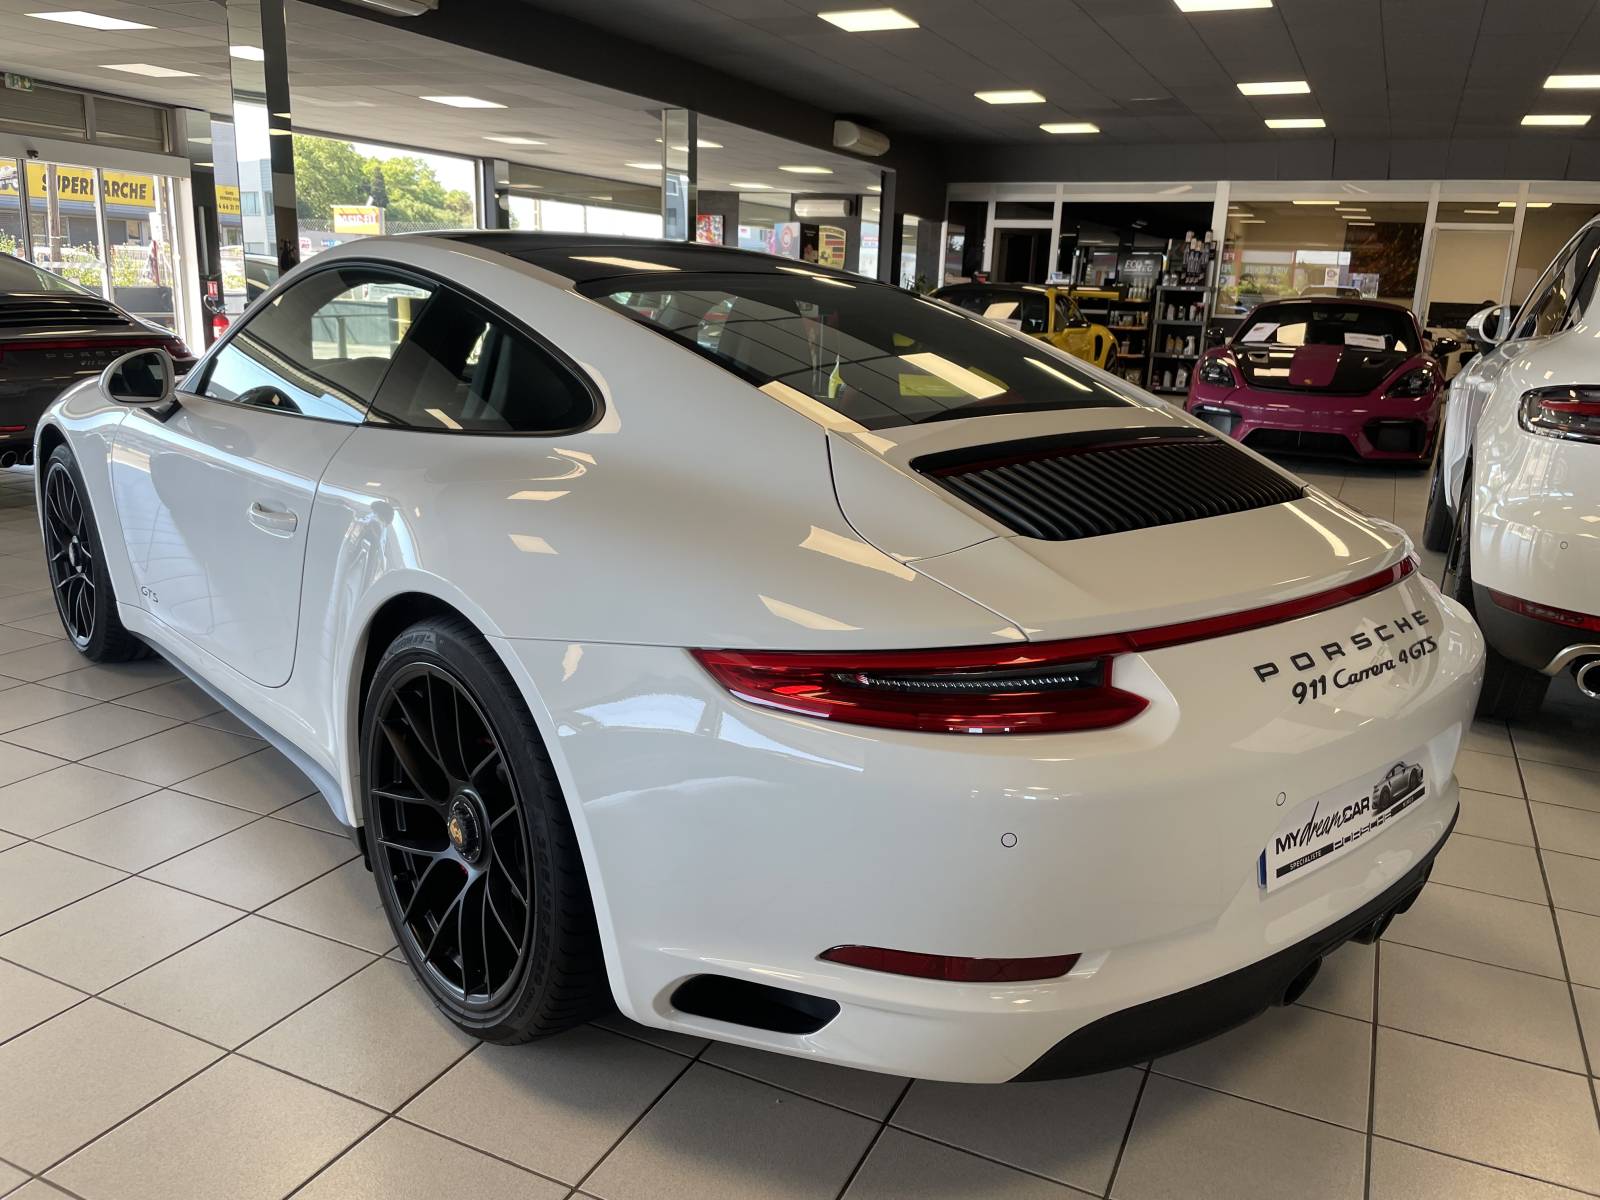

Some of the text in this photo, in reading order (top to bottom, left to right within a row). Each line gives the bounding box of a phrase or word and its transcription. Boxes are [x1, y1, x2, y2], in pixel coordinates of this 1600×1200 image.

[42, 173, 147, 200] SPERARCHE
[141, 586, 159, 603] GTS
[1253, 610, 1430, 683] PORSCHE
[1292, 674, 1327, 705] 911
[1333, 659, 1396, 689] Carrera
[1289, 850, 1322, 870] SPECIALISTE
